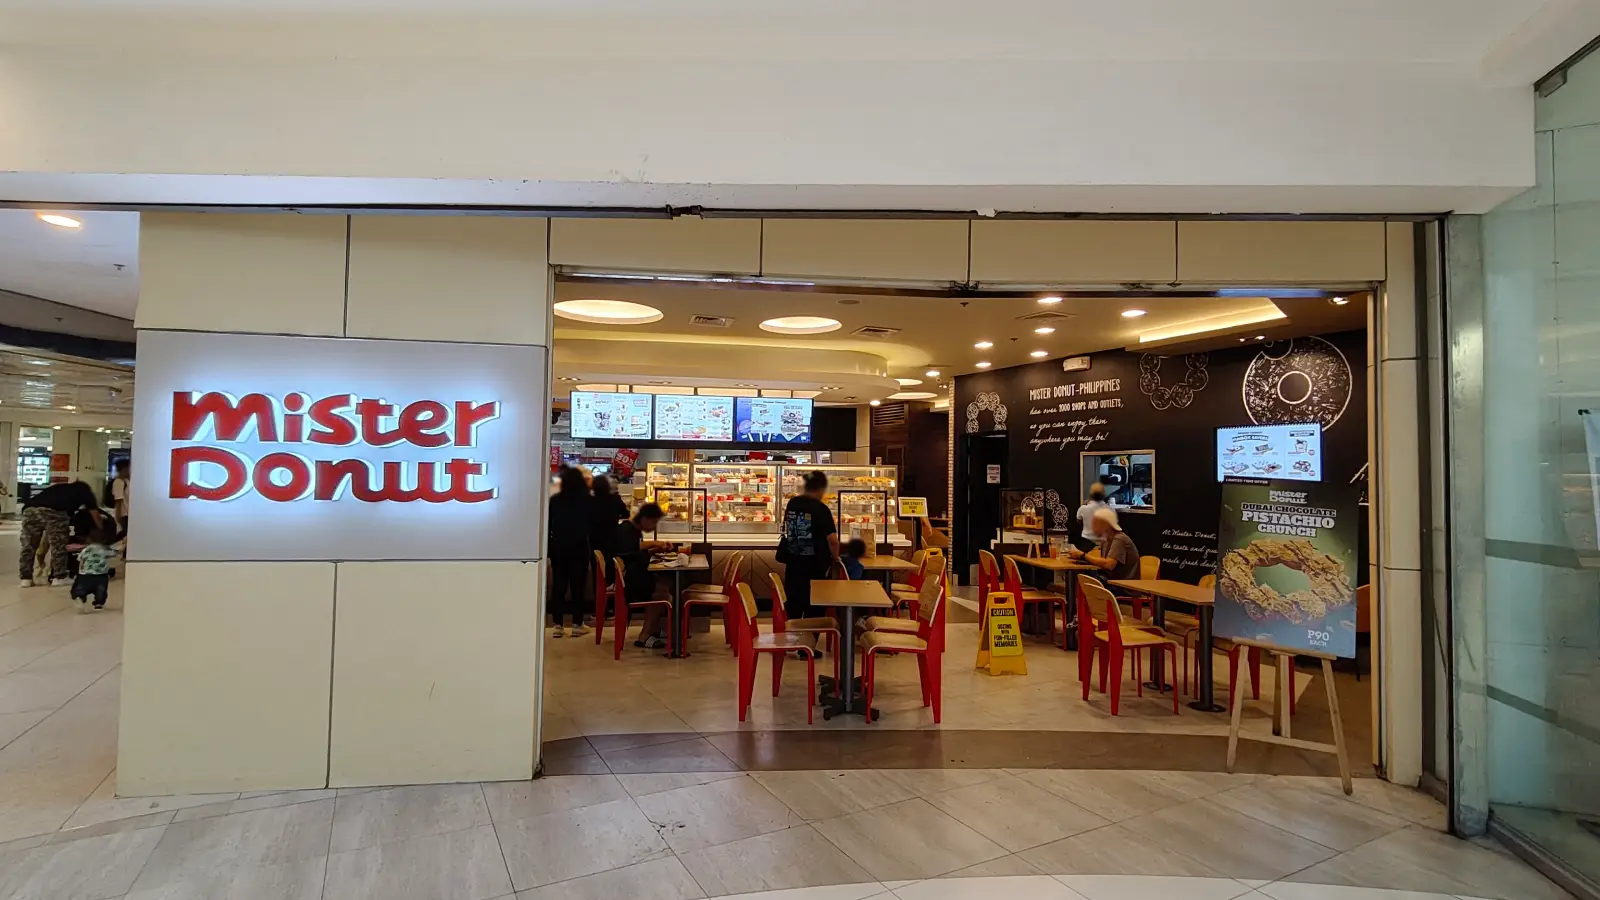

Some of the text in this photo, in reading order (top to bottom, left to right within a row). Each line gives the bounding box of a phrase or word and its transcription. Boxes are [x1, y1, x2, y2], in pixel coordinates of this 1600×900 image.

[1030, 379, 1120, 400] MISTER DONUT-PHILIPPINES
[1029, 406, 1041, 415] has
[1072, 401, 1086, 411] SHOPS
[1088, 400, 1098, 410] AND
[1036, 423, 1051, 437] you
[1067, 417, 1087, 434] enjoy
[1088, 416, 1108, 425] them
[1030, 431, 1109, 452] anywhere you may be!
[169, 446, 498, 503] Donut
[1241, 502, 1336, 517] DUBAI CHOCOLATE
[1242, 511, 1335, 528] PISTACHIO
[1258, 523, 1317, 537] CRUNCH
[1162, 556, 1180, 564] made
[1179, 558, 1199, 569] fresh
